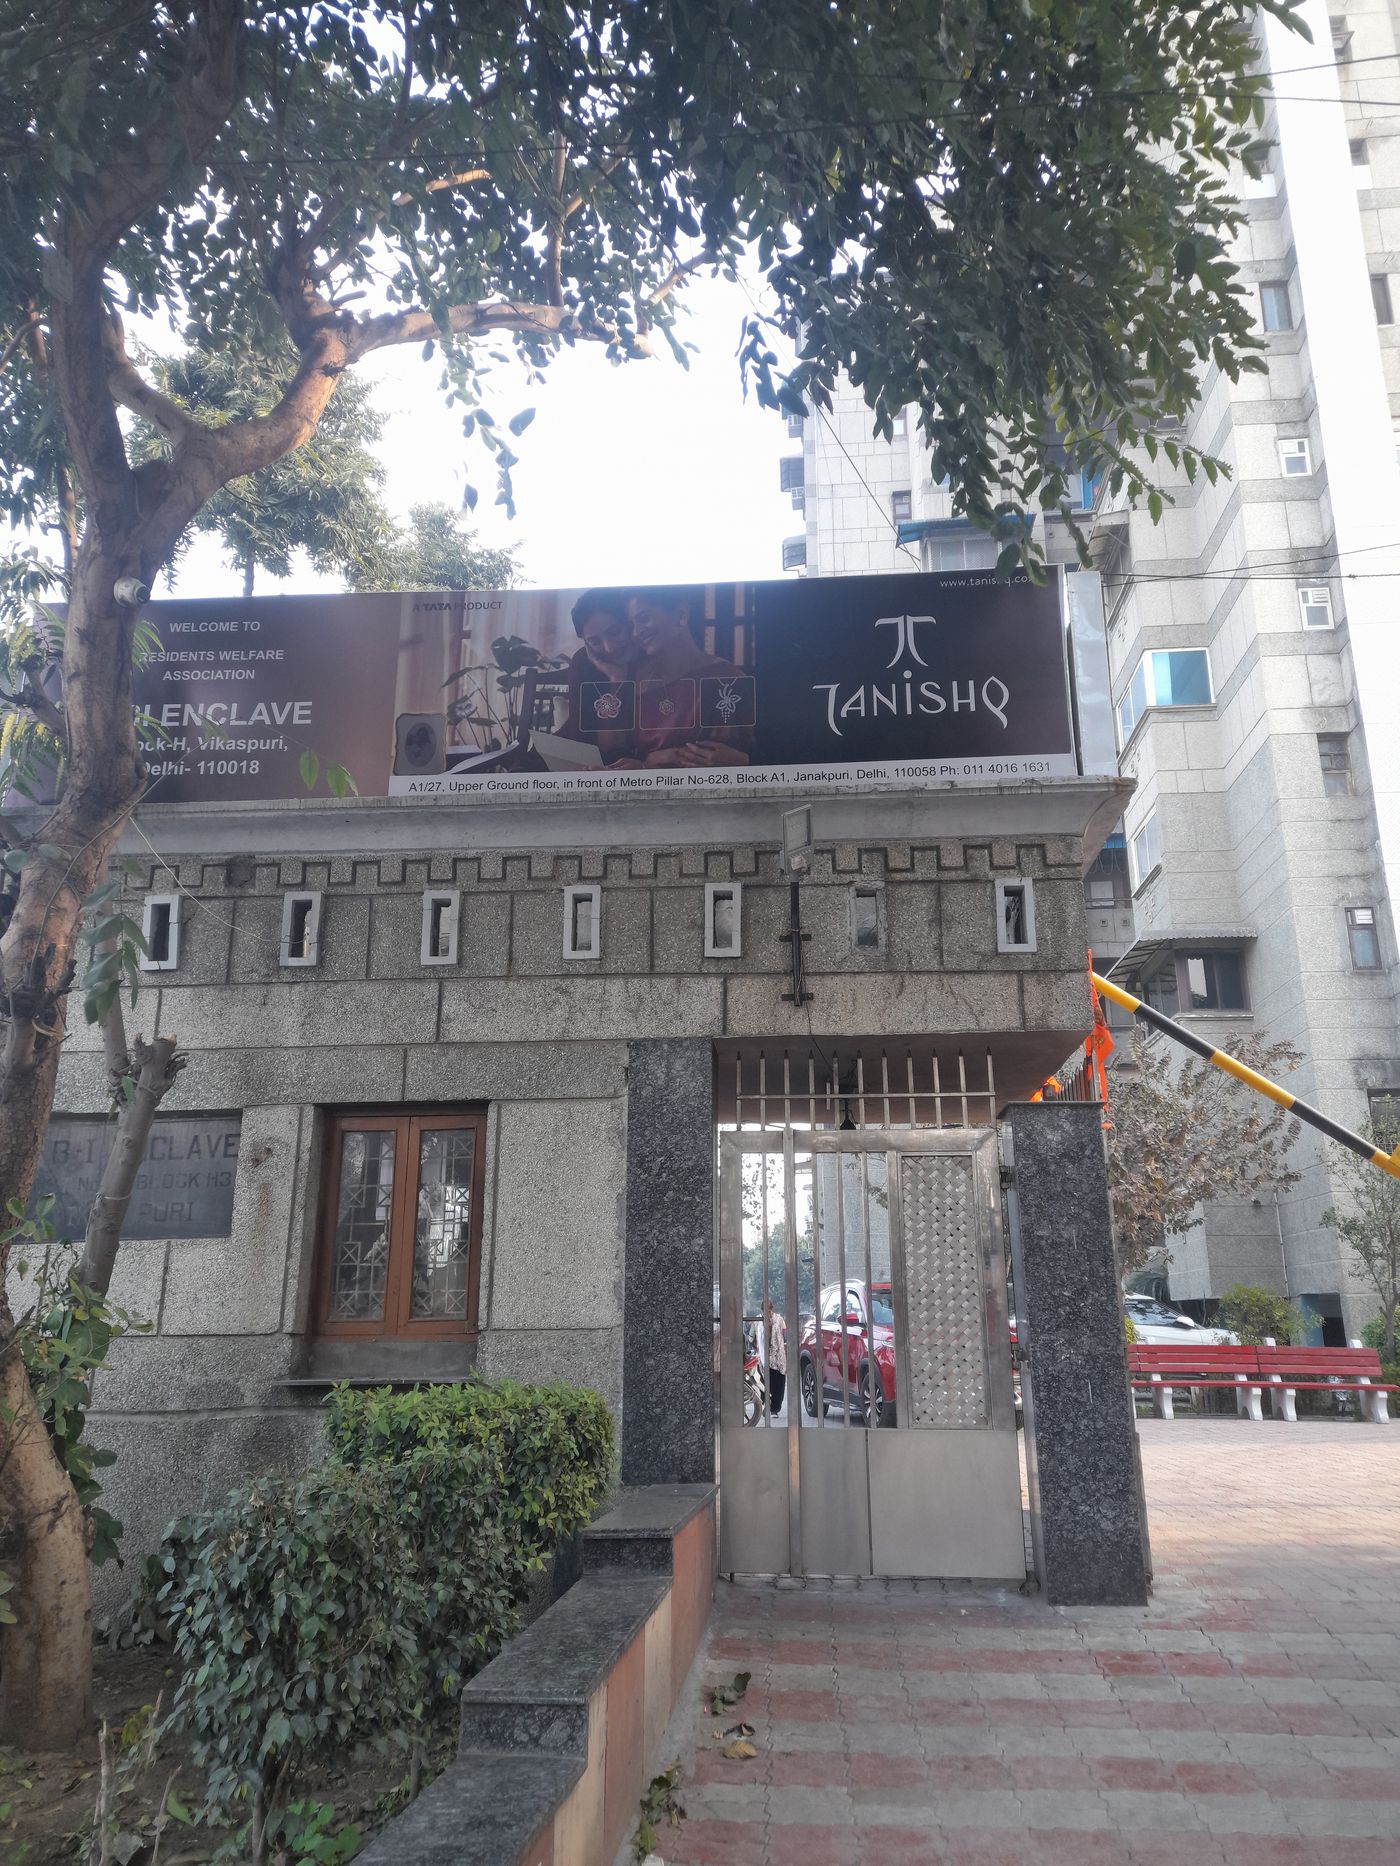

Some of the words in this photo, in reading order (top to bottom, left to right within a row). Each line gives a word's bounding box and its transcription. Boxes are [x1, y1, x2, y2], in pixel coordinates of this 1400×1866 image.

[424, 602, 452, 611] TATA
[455, 601, 503, 611] PRODUCT
[169, 621, 239, 633] WELCOME
[242, 621, 261, 632] TO
[139, 650, 215, 662] RESIDENTS
[219, 649, 284, 661] WELFARE
[163, 669, 255, 681] ASSOCIATION
[160, 701, 313, 727] ENCLAVE
[198, 735, 289, 754] Vikaspuri,
[198, 760, 260, 775] 110018
[408, 782, 445, 793] A1/27,
[450, 781, 483, 793] Upper
[487, 780, 529, 791] Ground
[532, 779, 560, 790] floor,
[563, 779, 573, 789] in
[577, 778, 603, 788] front
[606, 778, 617, 788] of
[620, 777, 652, 788] Metro
[656, 776, 684, 786] Pillar
[688, 774, 732, 786] No-628,
[737, 773, 767, 784] Block
[770, 772, 790, 783] A1,
[793, 769, 853, 783] Janakpuri,
[857, 768, 890, 780] Delhi,
[894, 766, 936, 777] 110058
[940, 765, 960, 776] Ph:
[963, 764, 983, 775] 011
[988, 763, 1018, 774] 4016
[1022, 761, 1050, 773] 1631
